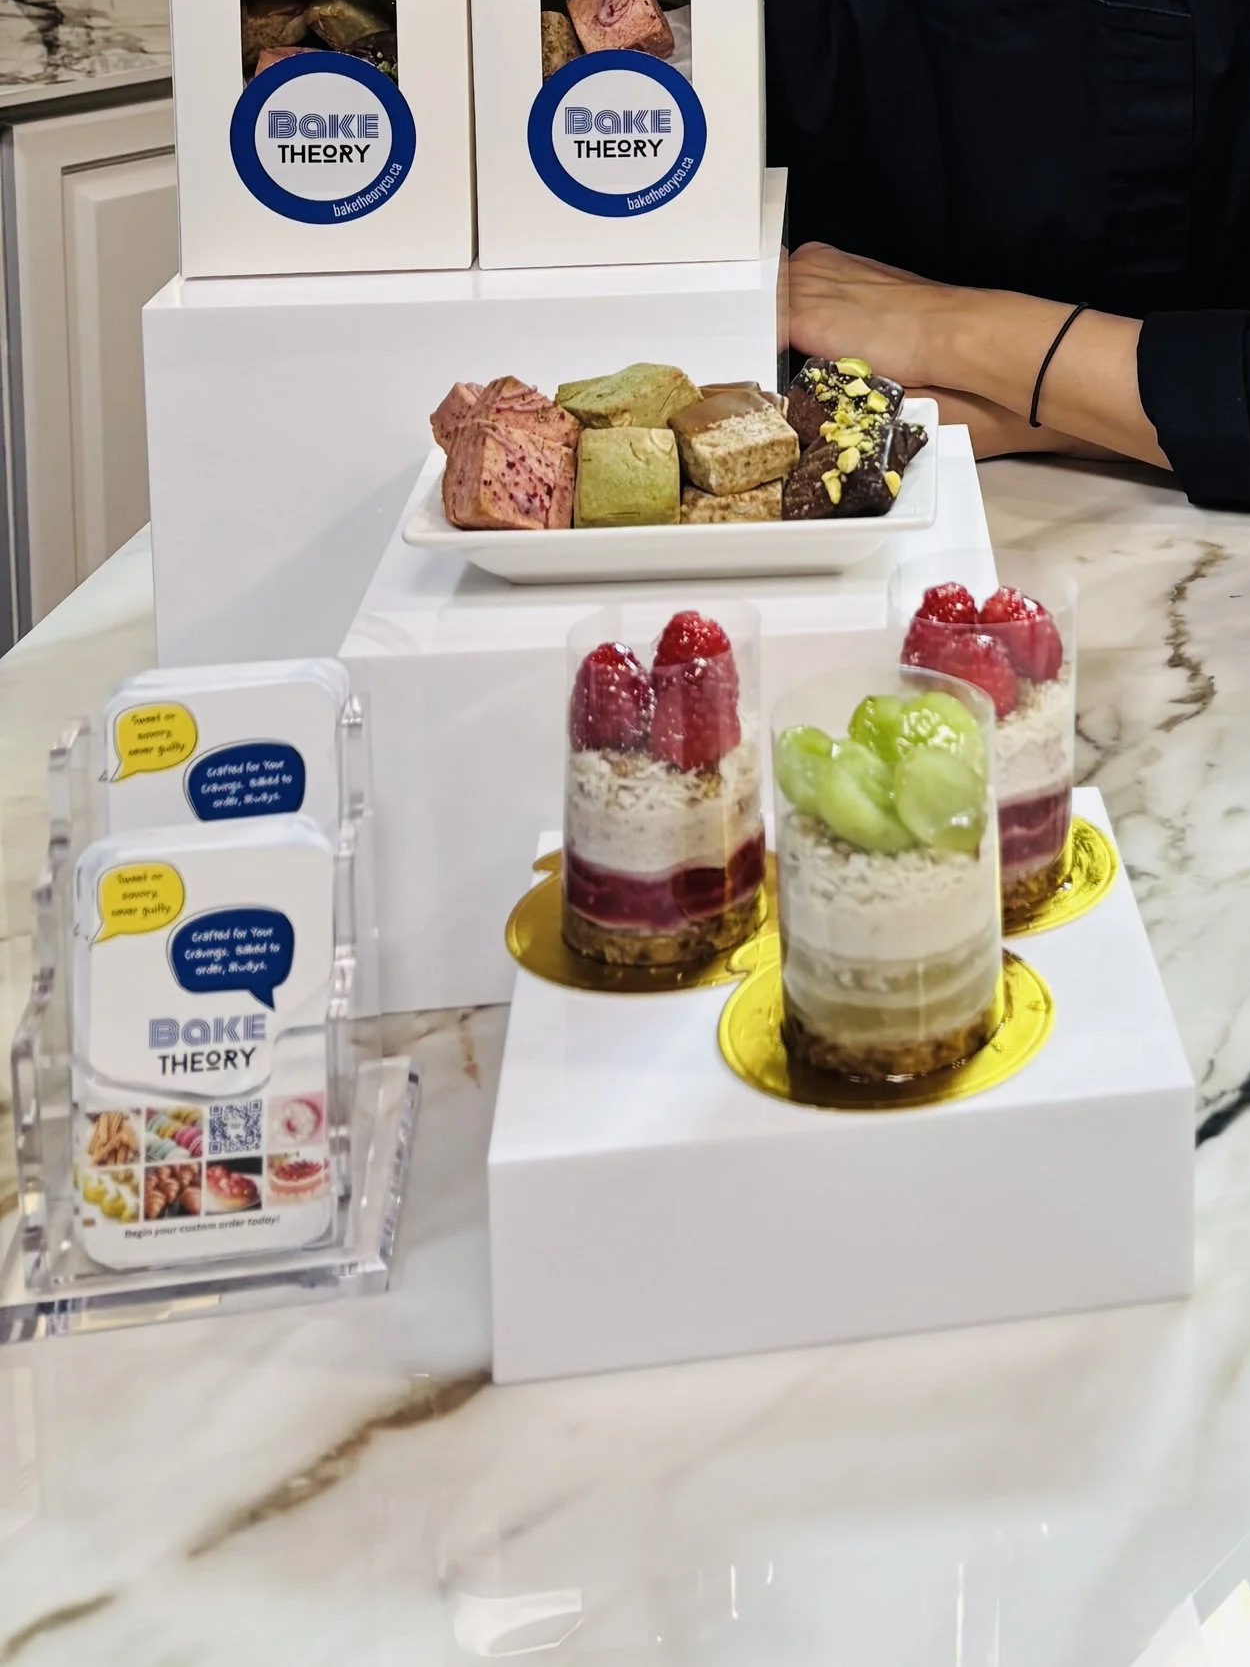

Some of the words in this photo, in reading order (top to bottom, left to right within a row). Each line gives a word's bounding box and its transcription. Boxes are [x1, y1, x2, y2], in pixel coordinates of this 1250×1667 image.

[277, 144, 371, 164] THEORY
[574, 139, 664, 159] THEORY
[333, 162, 403, 217] baketheoryco.ca
[627, 156, 695, 211] baketheoryco.ca
[131, 712, 161, 726] Sweet
[163, 713, 176, 721] or
[128, 746, 154, 756] never
[157, 741, 185, 757] guilty
[207, 762, 244, 778] Crafted
[246, 760, 260, 773] for
[263, 759, 285, 771] Your
[281, 773, 293, 785] to
[212, 795, 242, 809] order,
[116, 871, 147, 885] Sweet
[151, 873, 163, 881] or
[111, 907, 138, 917] never
[142, 902, 171, 919] guilty
[191, 927, 230, 943] Crafted
[233, 927, 248, 940] for
[250, 926, 274, 938] Your
[184, 947, 230, 962] Cravings.
[235, 941, 267, 956] Baked
[269, 941, 281, 953] to
[195, 963, 227, 976] order,
[158, 1047, 256, 1076] THEORY
[124, 1229, 153, 1239] Begin
[153, 1227, 177, 1238] your
[179, 1223, 217, 1234] custom
[218, 1219, 245, 1230] order
[247, 1214, 280, 1227] today!
